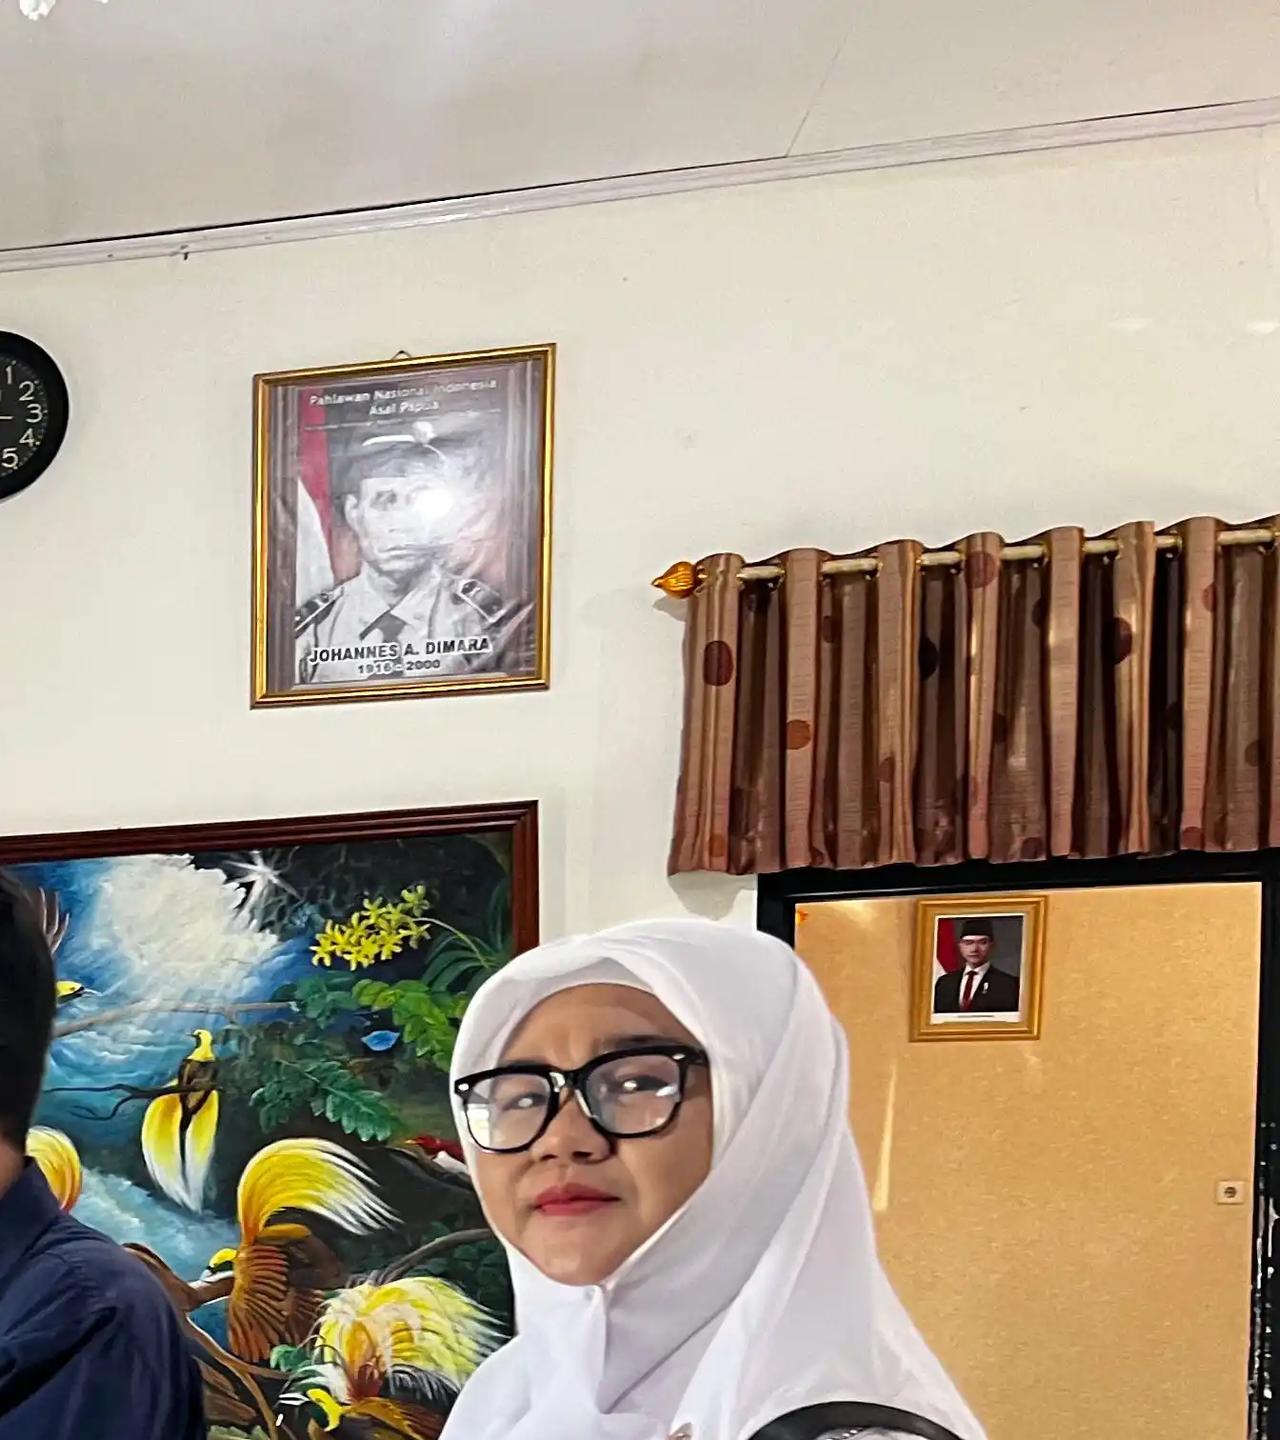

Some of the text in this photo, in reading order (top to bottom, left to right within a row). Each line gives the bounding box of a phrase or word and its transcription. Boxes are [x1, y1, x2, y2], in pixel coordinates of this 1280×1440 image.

[5, 365, 13, 385] 1
[19, 381, 35, 401] 2
[25, 403, 43, 423] 3
[19, 428, 36, 447] 4
[1, 447, 19, 468] 5
[309, 637, 490, 663] JOHANNES A. DIMARA
